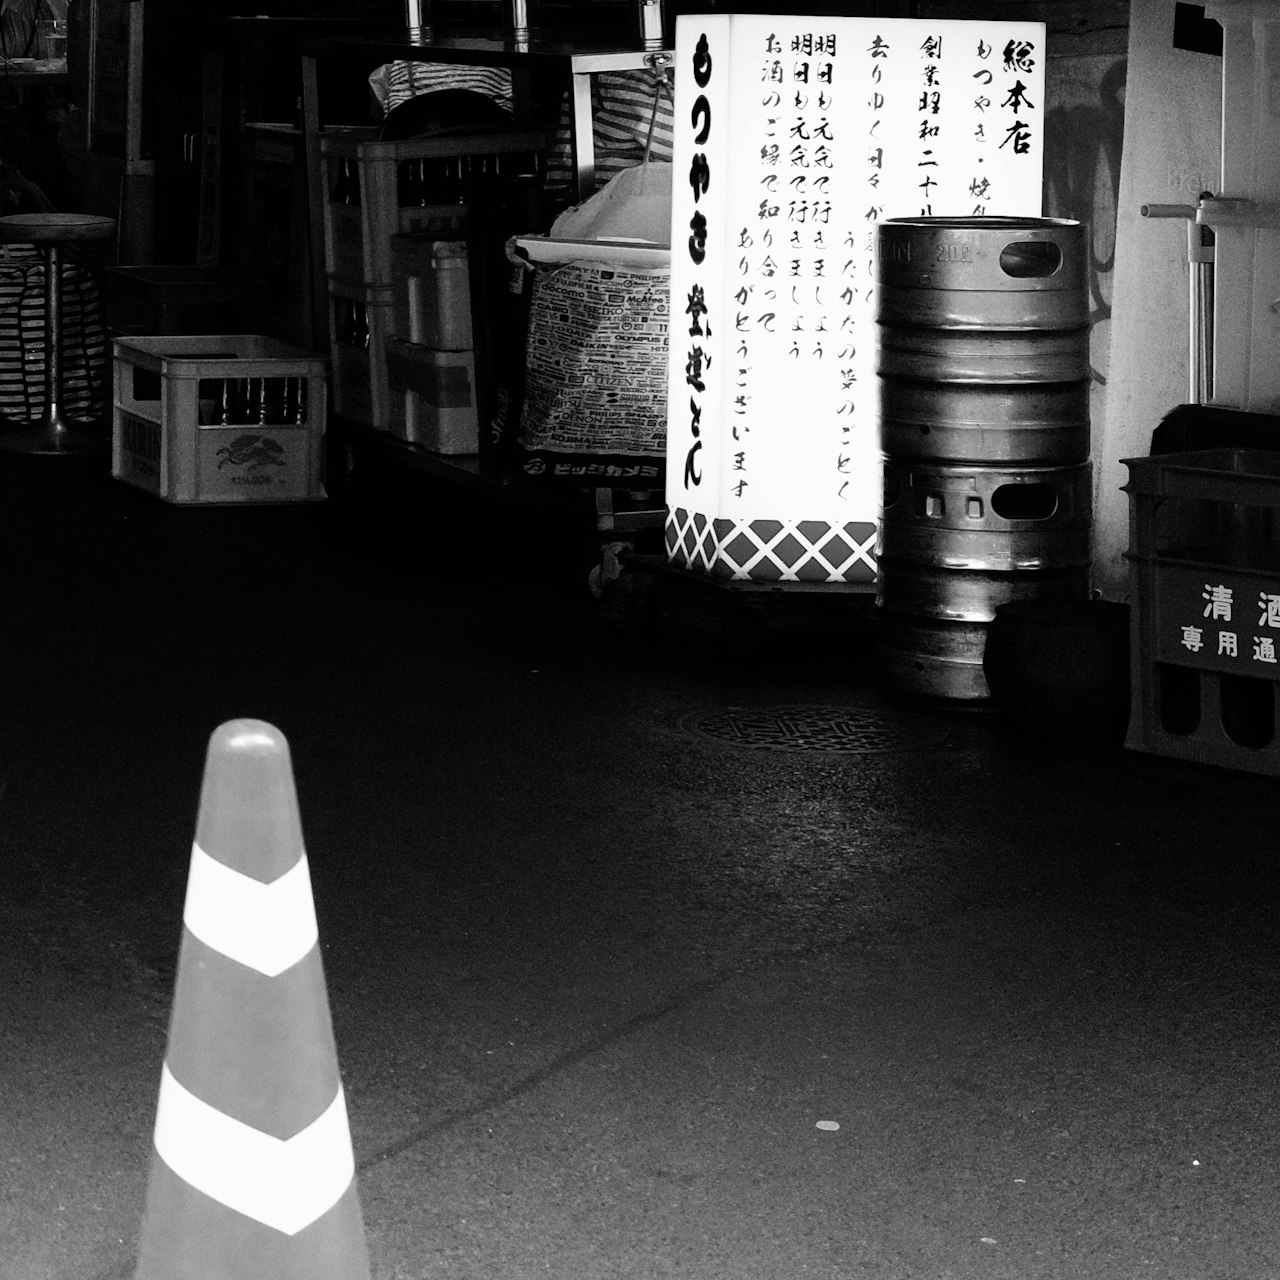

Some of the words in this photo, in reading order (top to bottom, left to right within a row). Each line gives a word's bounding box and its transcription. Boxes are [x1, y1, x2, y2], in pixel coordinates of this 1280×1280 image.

[998, 38, 1036, 155] 総本店
[756, 32, 783, 332] お酒のご縁で知り合って
[786, 32, 813, 360] 明日も元気で行きましょう
[812, 32, 837, 360] 明日も元気で行きましょう
[630, 273, 661, 281] PHILIPS
[541, 283, 585, 298] docomo
[626, 296, 664, 304] McAfee
[537, 302, 569, 314] CASIO
[584, 304, 624, 316] SEIKO
[570, 339, 609, 350] DAIKIN
[614, 335, 661, 344] OLYMPUS
[587, 357, 624, 366] lenovo
[730, 227, 755, 499] ありがとうございます
[837, 231, 858, 501] うたかたの夢のごとく
[586, 375, 634, 388] CITIZEN
[562, 412, 603, 424] DENON
[551, 433, 591, 444] KOJIMA
[1201, 583, 1280, 629] 清酒
[1180, 625, 1278, 663] 専用通
